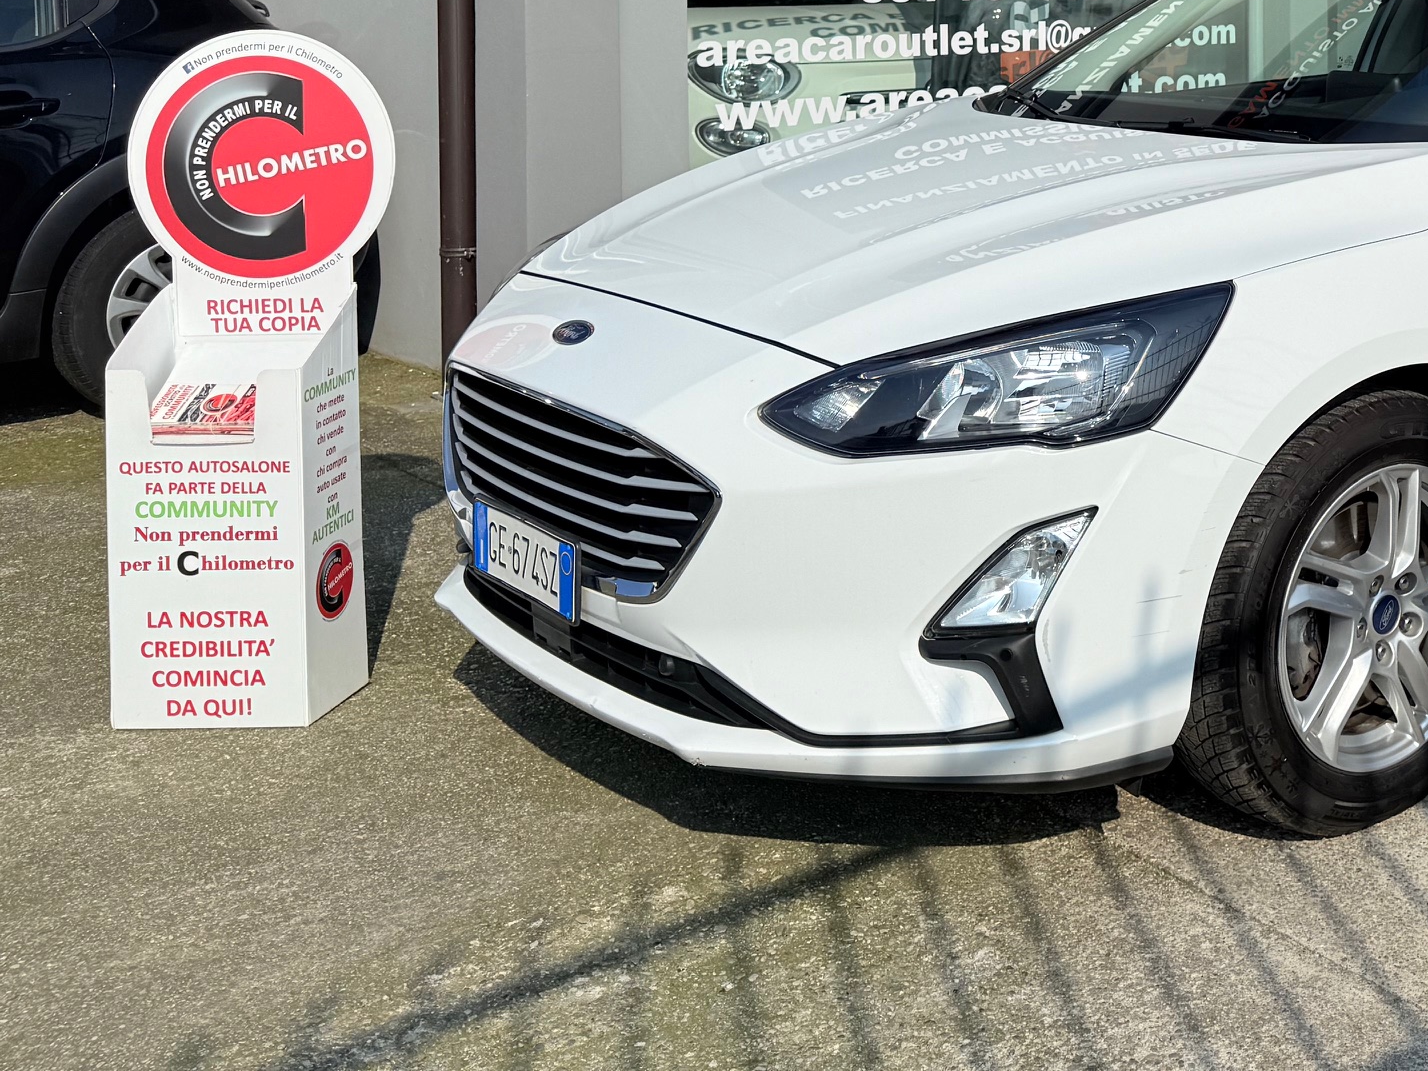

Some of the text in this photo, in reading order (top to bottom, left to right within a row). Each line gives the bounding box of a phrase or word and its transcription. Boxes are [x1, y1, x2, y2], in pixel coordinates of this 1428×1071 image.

[194, 42, 344, 79] Non prendermi per il Chilometro
[193, 99, 299, 201] NON PRENDERMI PER IL
[181, 253, 344, 290] www.nonprendermiperilchilometro.it
[206, 297, 324, 316] RICHIEDI LA
[211, 316, 322, 333] TUA COPIA
[327, 367, 334, 377] La
[304, 368, 356, 402] COMMUNITY
[316, 394, 345, 413] che mette
[316, 409, 346, 430] in contatto
[317, 425, 344, 445] chi vende
[325, 446, 336, 457] con
[119, 460, 291, 476] QUESTO AUTOSALONE
[316, 455, 347, 478] chi compra
[145, 481, 267, 495] FA PARTE DELLA
[316, 471, 346, 494] auto usate
[327, 492, 338, 503] con
[134, 500, 278, 519] COMMUNITY
[326, 501, 340, 521] KM
[134, 525, 279, 547] Non prendermi
[312, 509, 354, 545] AUTENTICI
[119, 550, 295, 577] per il Chilometro
[147, 610, 269, 628] LA NOSTRA
[151, 669, 266, 688] COMINCIA
[166, 697, 252, 719] DA QUI!
